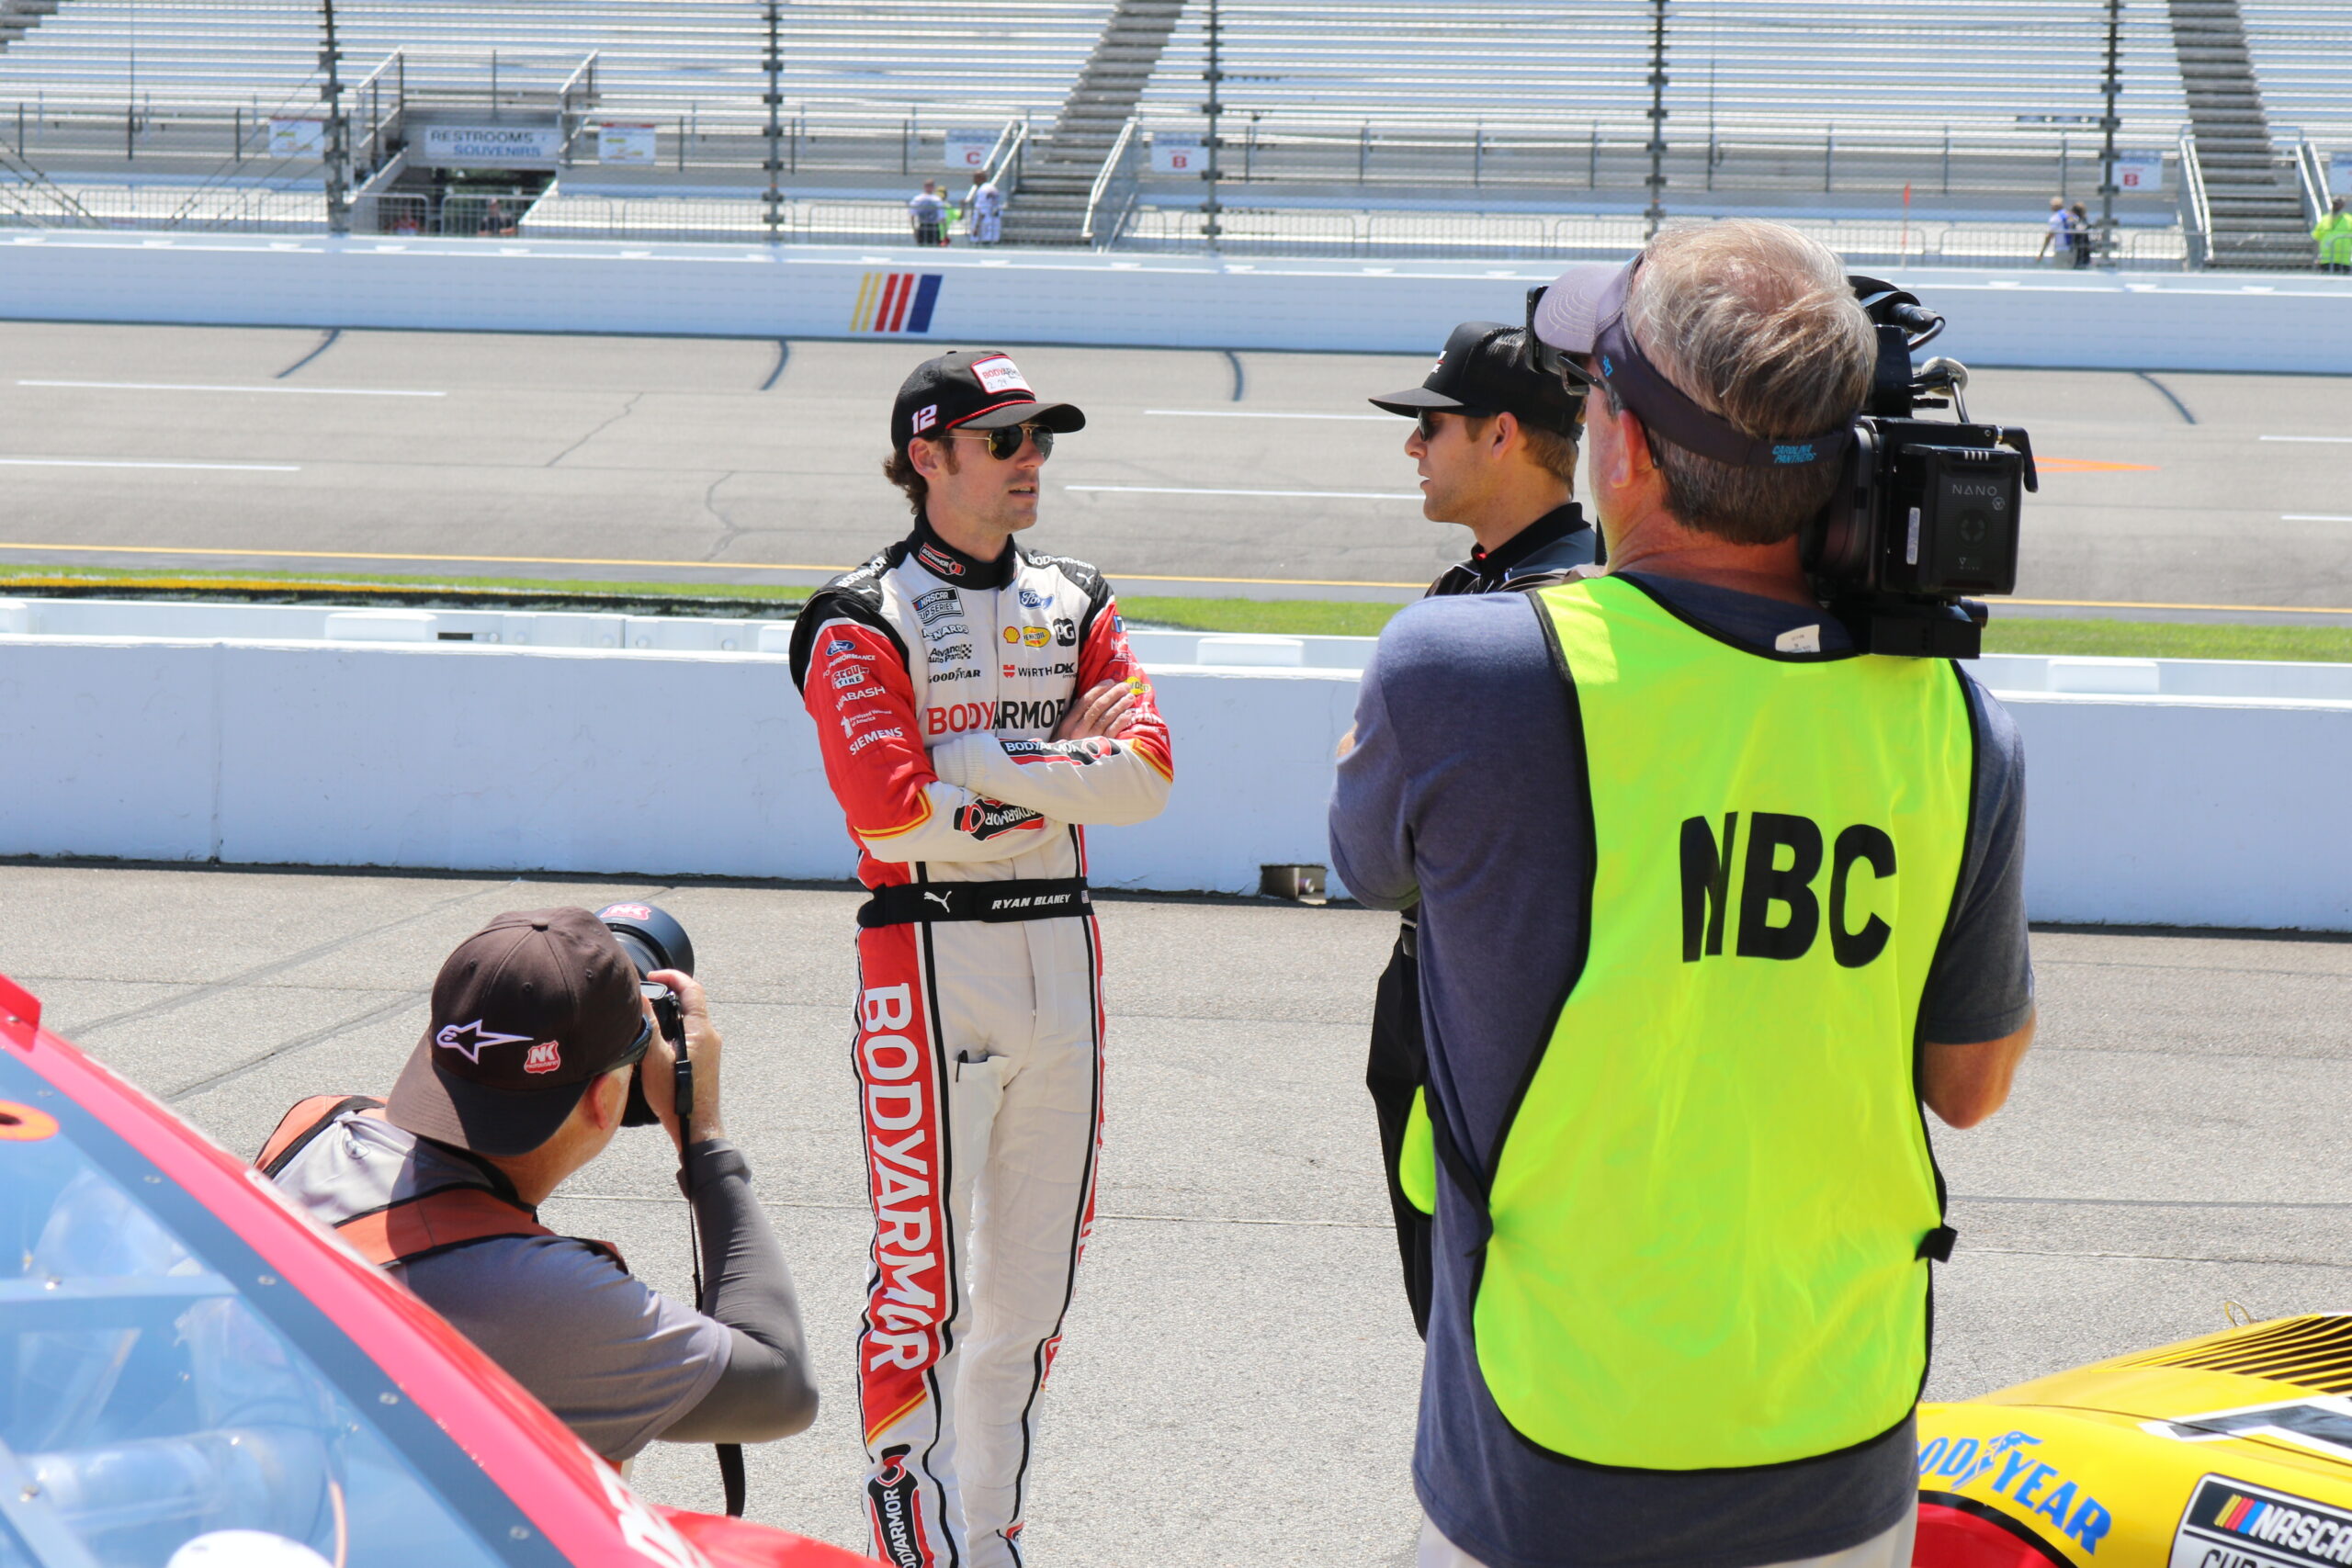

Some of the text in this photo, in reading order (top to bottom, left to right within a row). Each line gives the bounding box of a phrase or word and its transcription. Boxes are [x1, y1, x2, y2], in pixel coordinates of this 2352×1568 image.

[431, 130, 533, 143] RESTROOMS
[454, 144, 540, 157] SOUVENIRS
[966, 152, 980, 164] C
[1171, 155, 1187, 168] B
[2124, 174, 2139, 186] B
[982, 367, 1022, 379] BODYARM
[911, 404, 937, 435] 12
[1951, 484, 1997, 496] NANO
[921, 591, 949, 607] NASCAR
[919, 603, 955, 620] UP SERIES
[838, 675, 861, 686] TIRE
[928, 669, 981, 683] OODYAR
[836, 686, 886, 711] WABASH
[850, 728, 903, 755] SIEMENS
[985, 807, 1036, 826] ODYARMOR
[1679, 811, 1897, 968] NBC
[991, 894, 1071, 910] RYAN BLANEY
[530, 1043, 556, 1064] NK
[865, 983, 935, 1373] BODYARMOR
[1917, 1431, 2112, 1556] ODYEAR
[883, 1487, 917, 1568] ODYARMOR
[2248, 1503, 2352, 1565] NASCA
